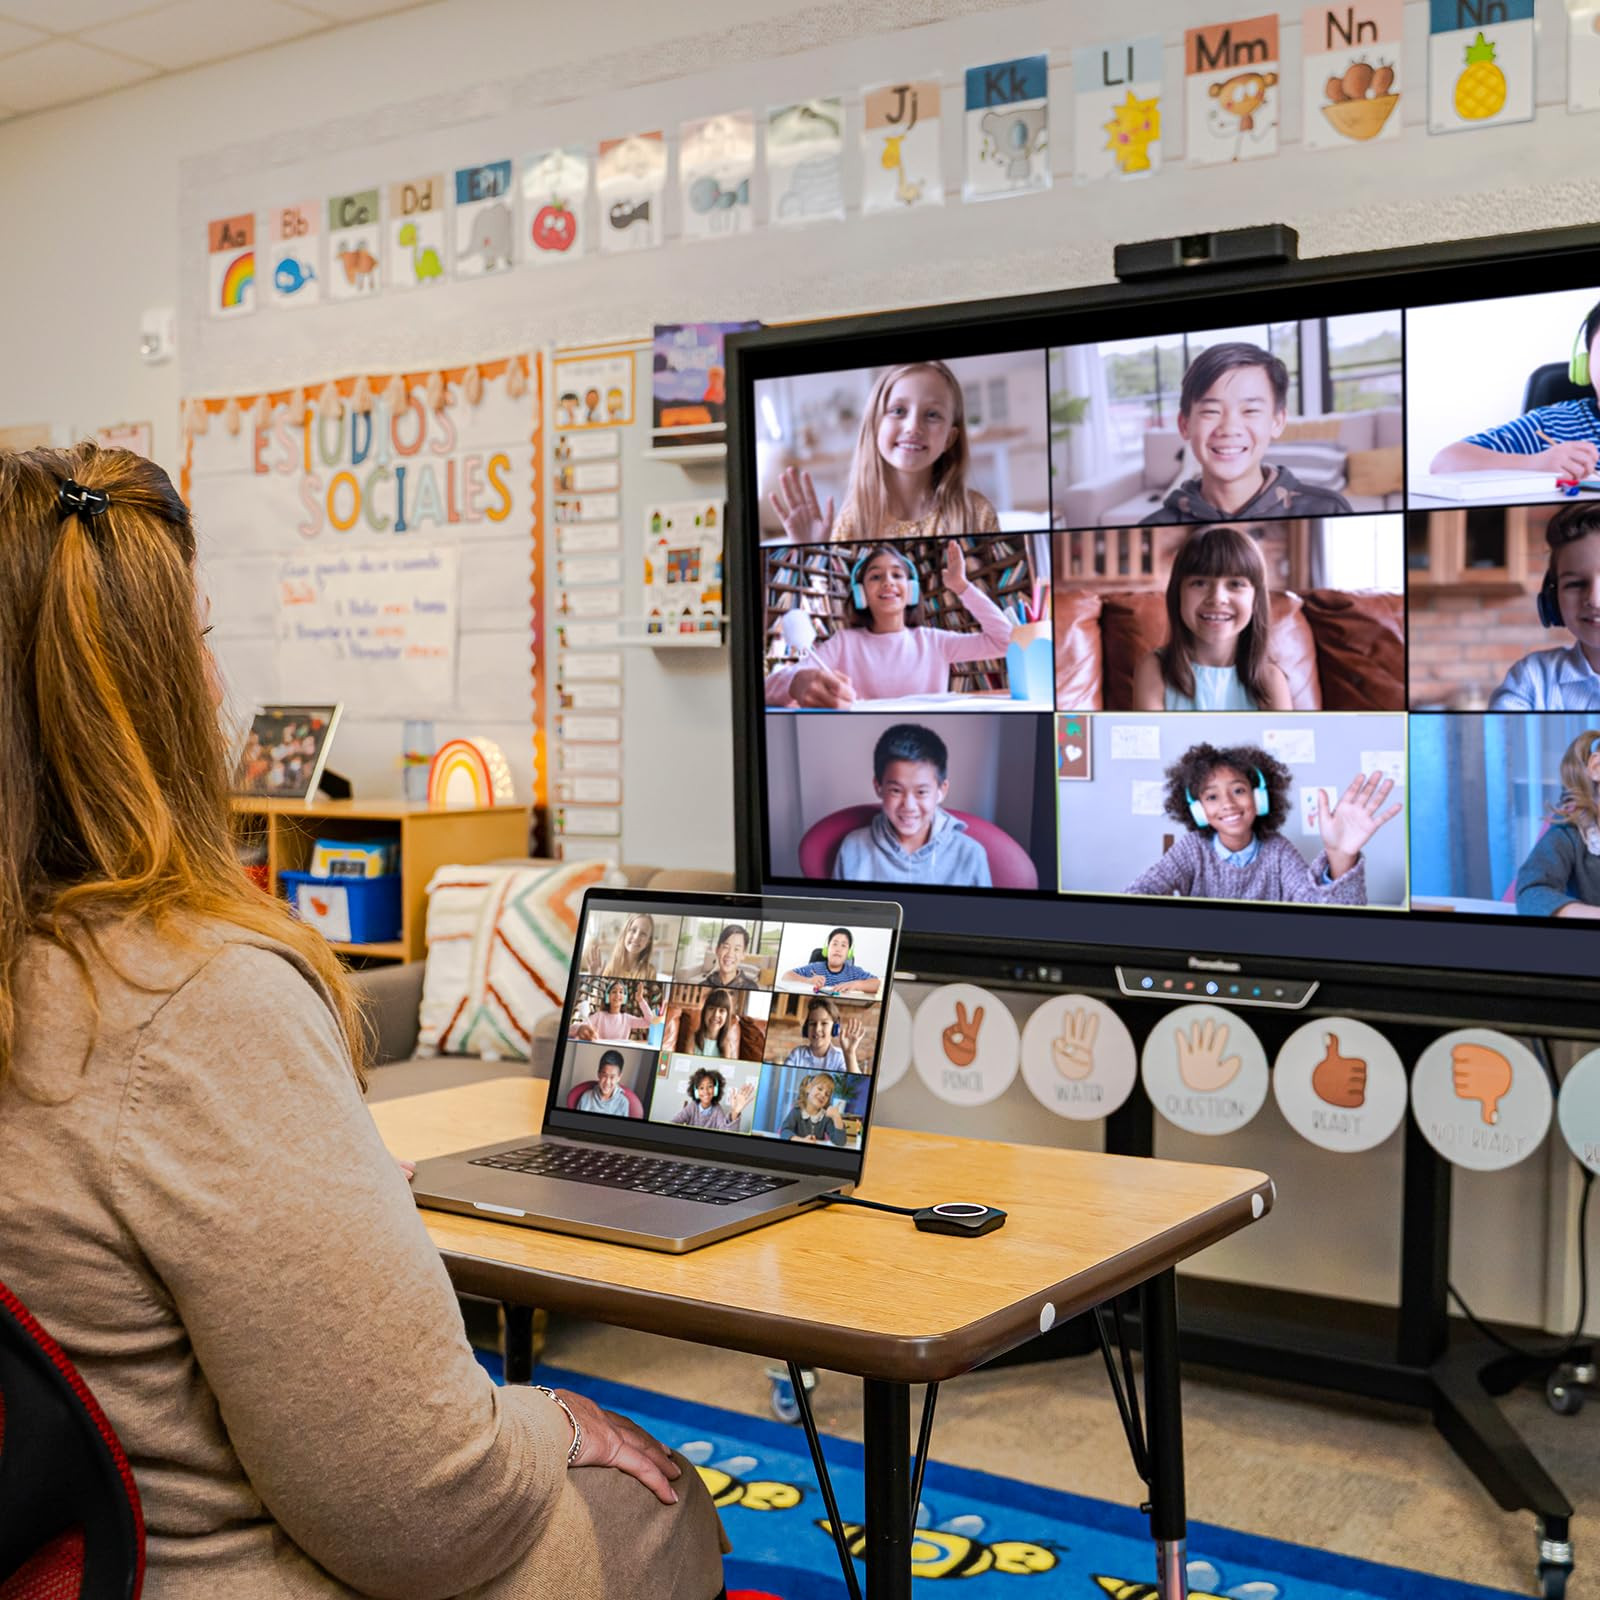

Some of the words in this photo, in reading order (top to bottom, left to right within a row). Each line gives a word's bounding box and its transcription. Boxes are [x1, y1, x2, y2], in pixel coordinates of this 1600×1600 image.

[1326, 7, 1378, 49] Nn
[1195, 29, 1269, 72] Mm
[984, 65, 1028, 105] Kk
[885, 85, 919, 131] Jj
[402, 177, 433, 215] Dd
[216, 223, 247, 250] Aa
[281, 208, 309, 240] Bb
[299, 454, 512, 538] SOCIALES
